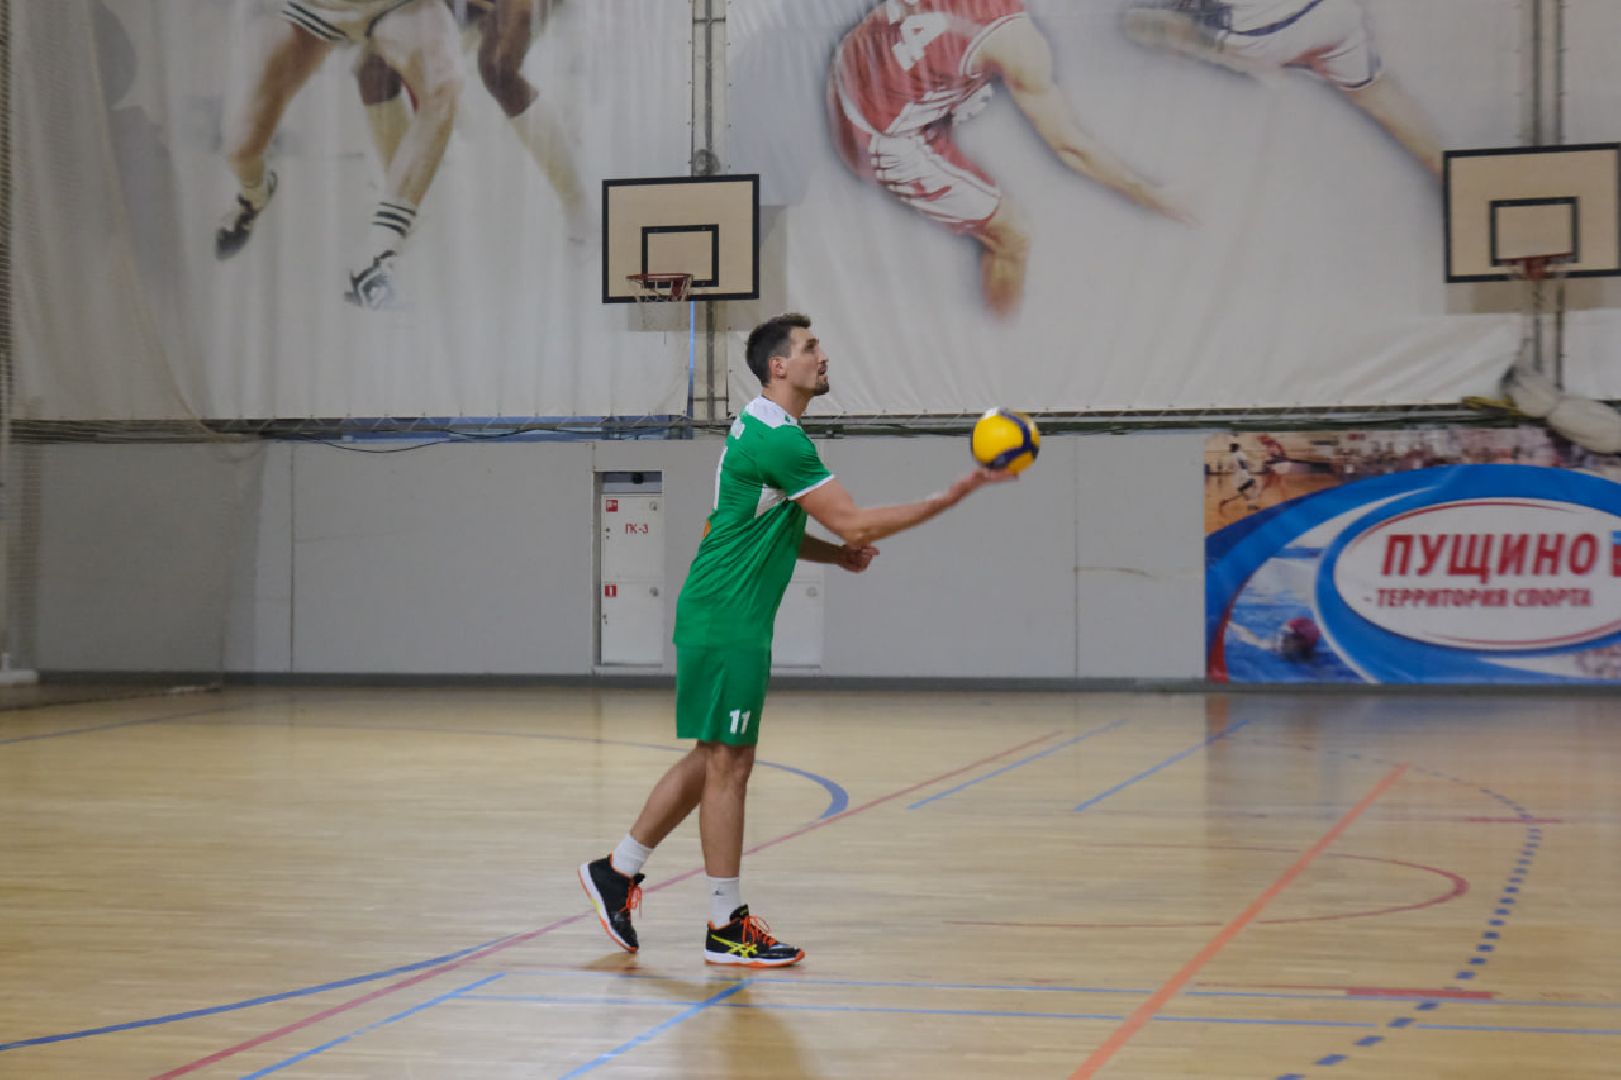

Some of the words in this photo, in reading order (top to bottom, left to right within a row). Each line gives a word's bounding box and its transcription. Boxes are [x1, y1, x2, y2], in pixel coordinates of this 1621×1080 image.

[1382, 533, 1600, 585] ПУЩИНО
[1376, 588, 1508, 608] ТЕРРИТОРИЯ
[1513, 588, 1593, 608] СПОРТА
[729, 709, 751, 735] 11
